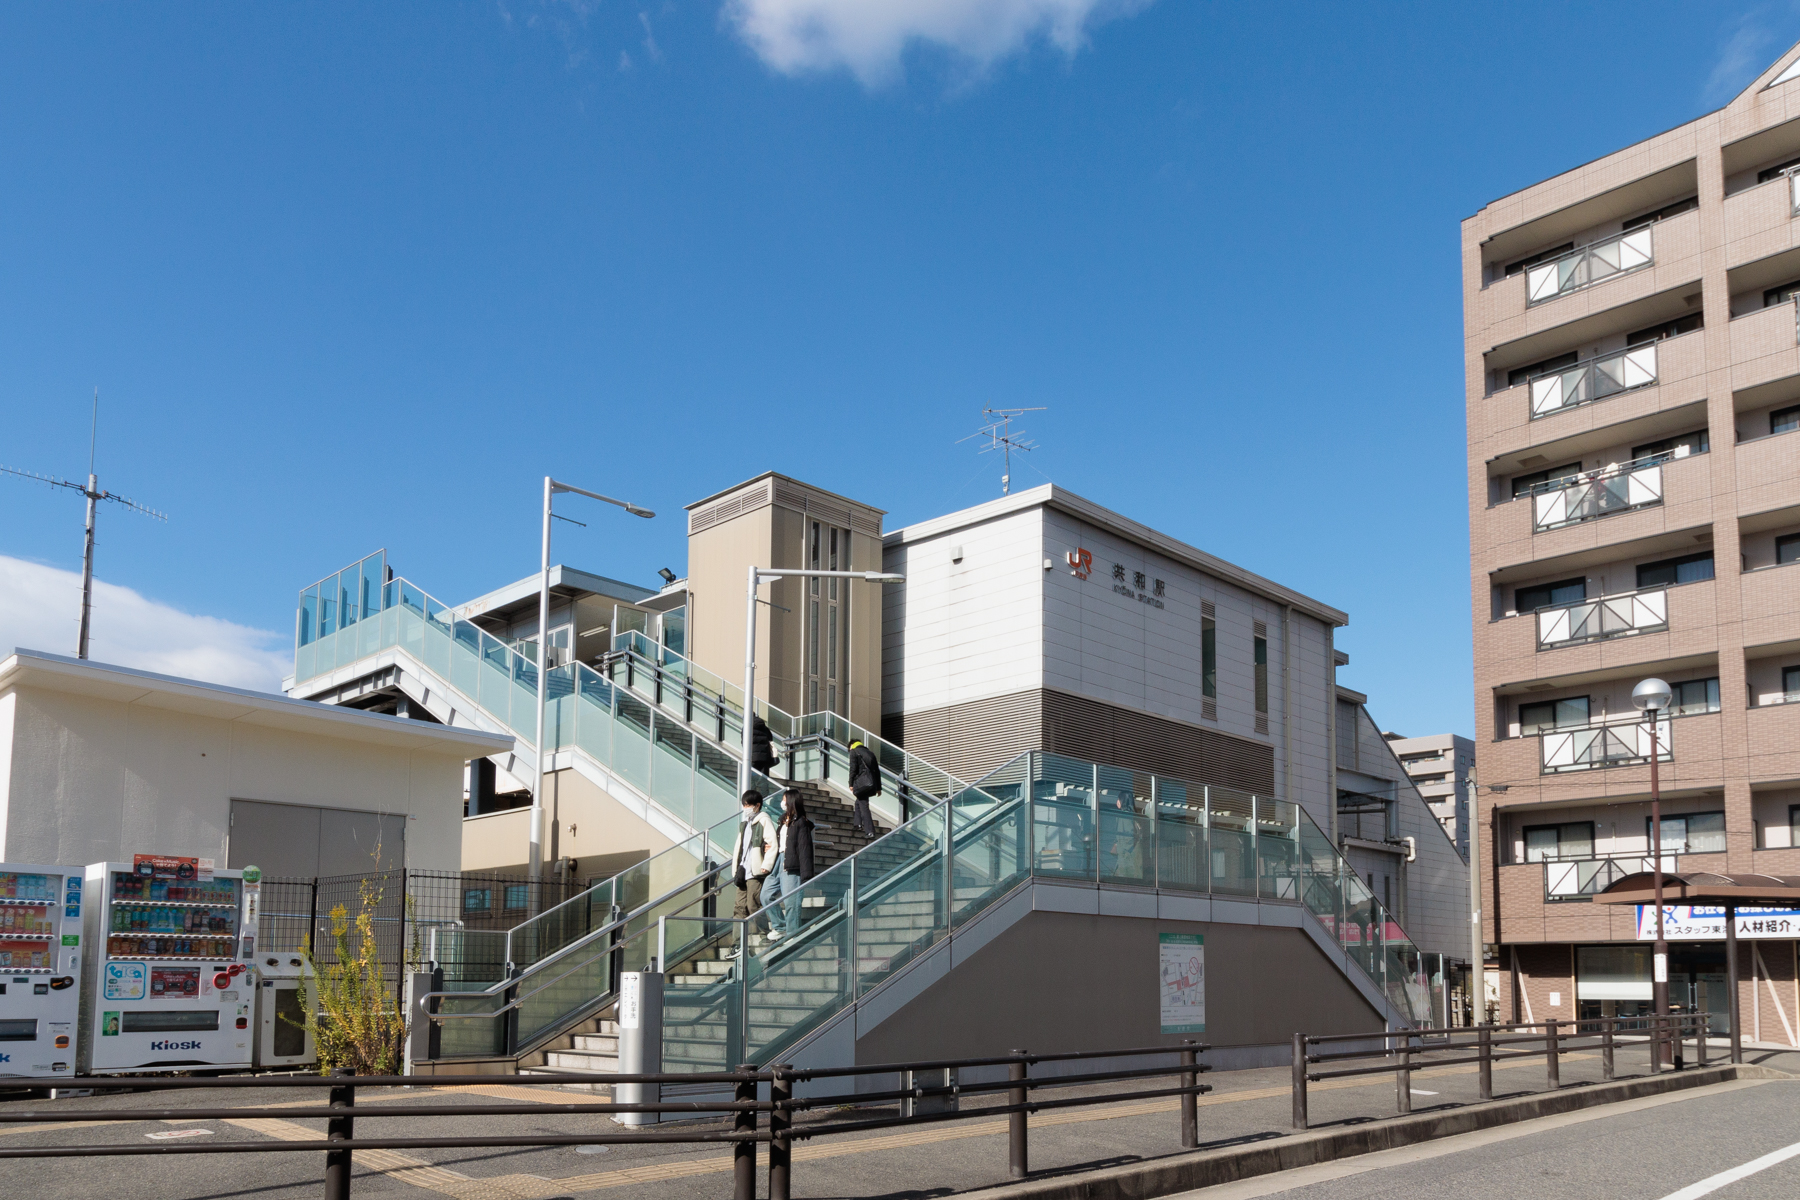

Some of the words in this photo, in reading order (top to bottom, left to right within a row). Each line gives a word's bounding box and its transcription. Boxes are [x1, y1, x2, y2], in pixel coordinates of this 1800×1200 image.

[1066, 547, 1093, 575] JR
[1112, 562, 1166, 598] 共和駅
[1137, 593, 1165, 610] STATION
[151, 1040, 201, 1050] Kiosk
